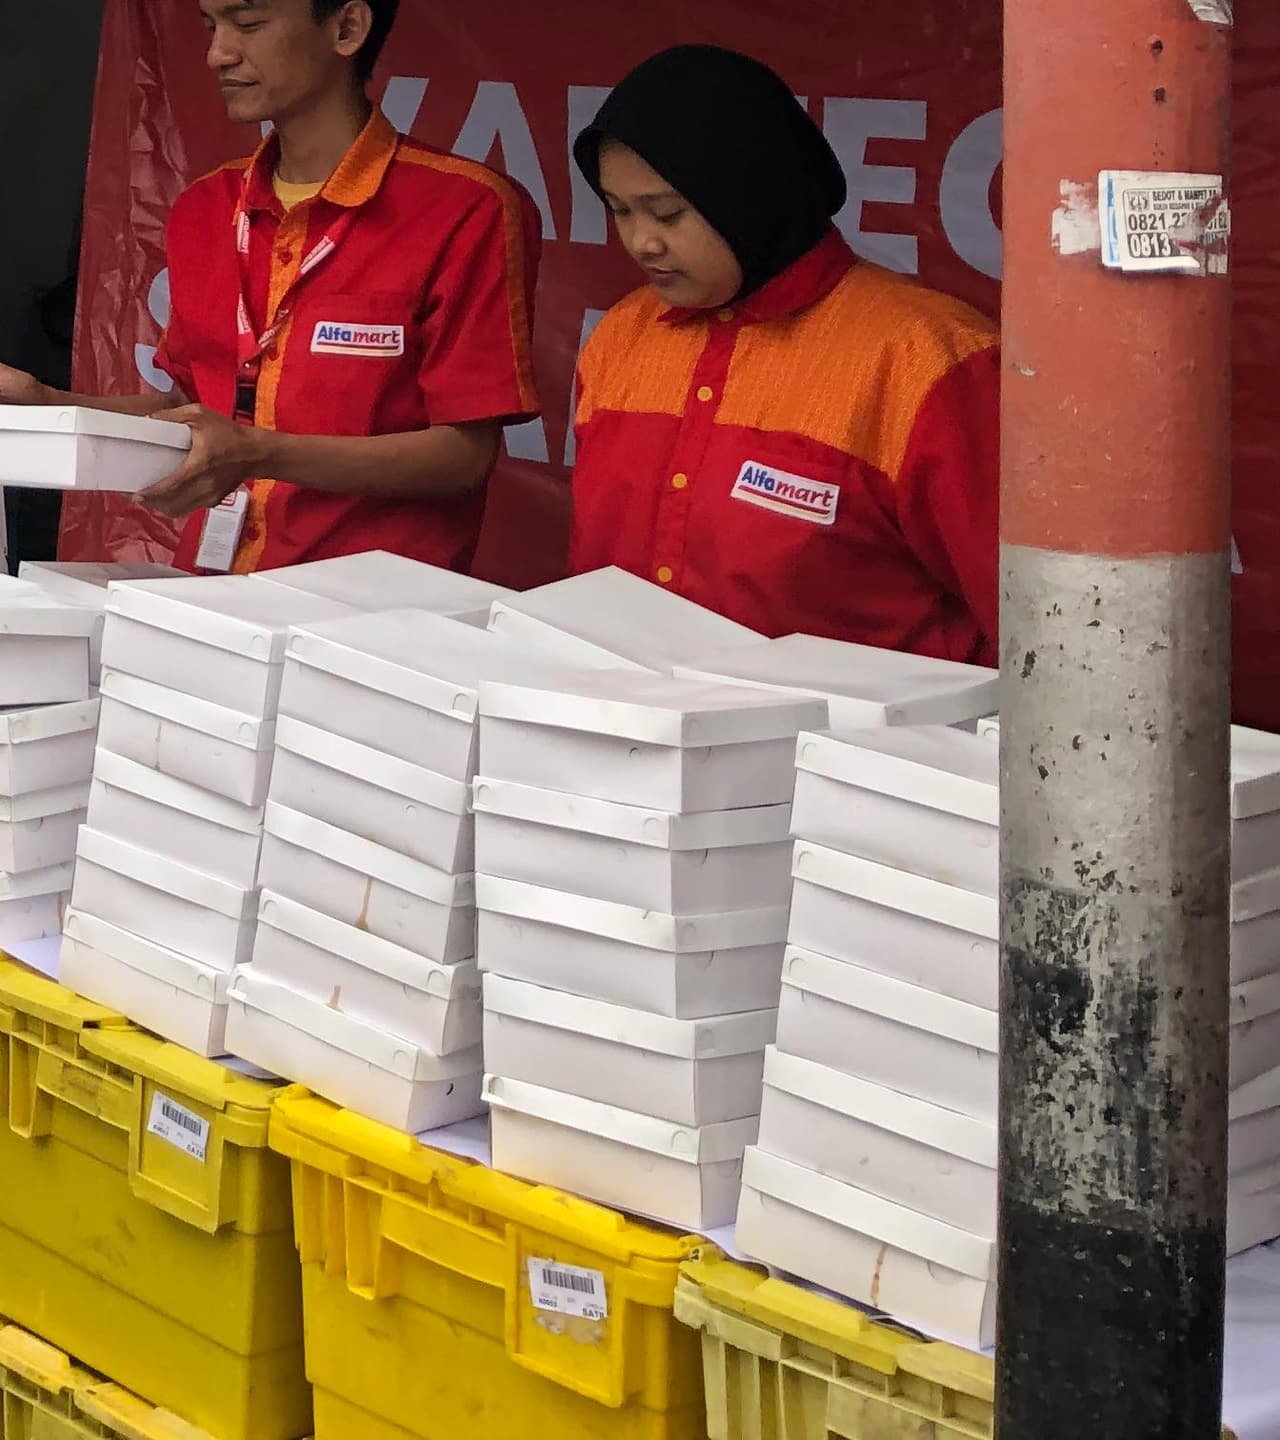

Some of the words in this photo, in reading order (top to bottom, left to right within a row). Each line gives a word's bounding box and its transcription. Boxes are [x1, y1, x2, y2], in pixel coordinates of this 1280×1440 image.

[1128, 212, 1167, 231] 0821
[1129, 233, 1171, 257] 0813
[317, 324, 401, 346] Alfamart
[740, 462, 836, 509] Alfamart
